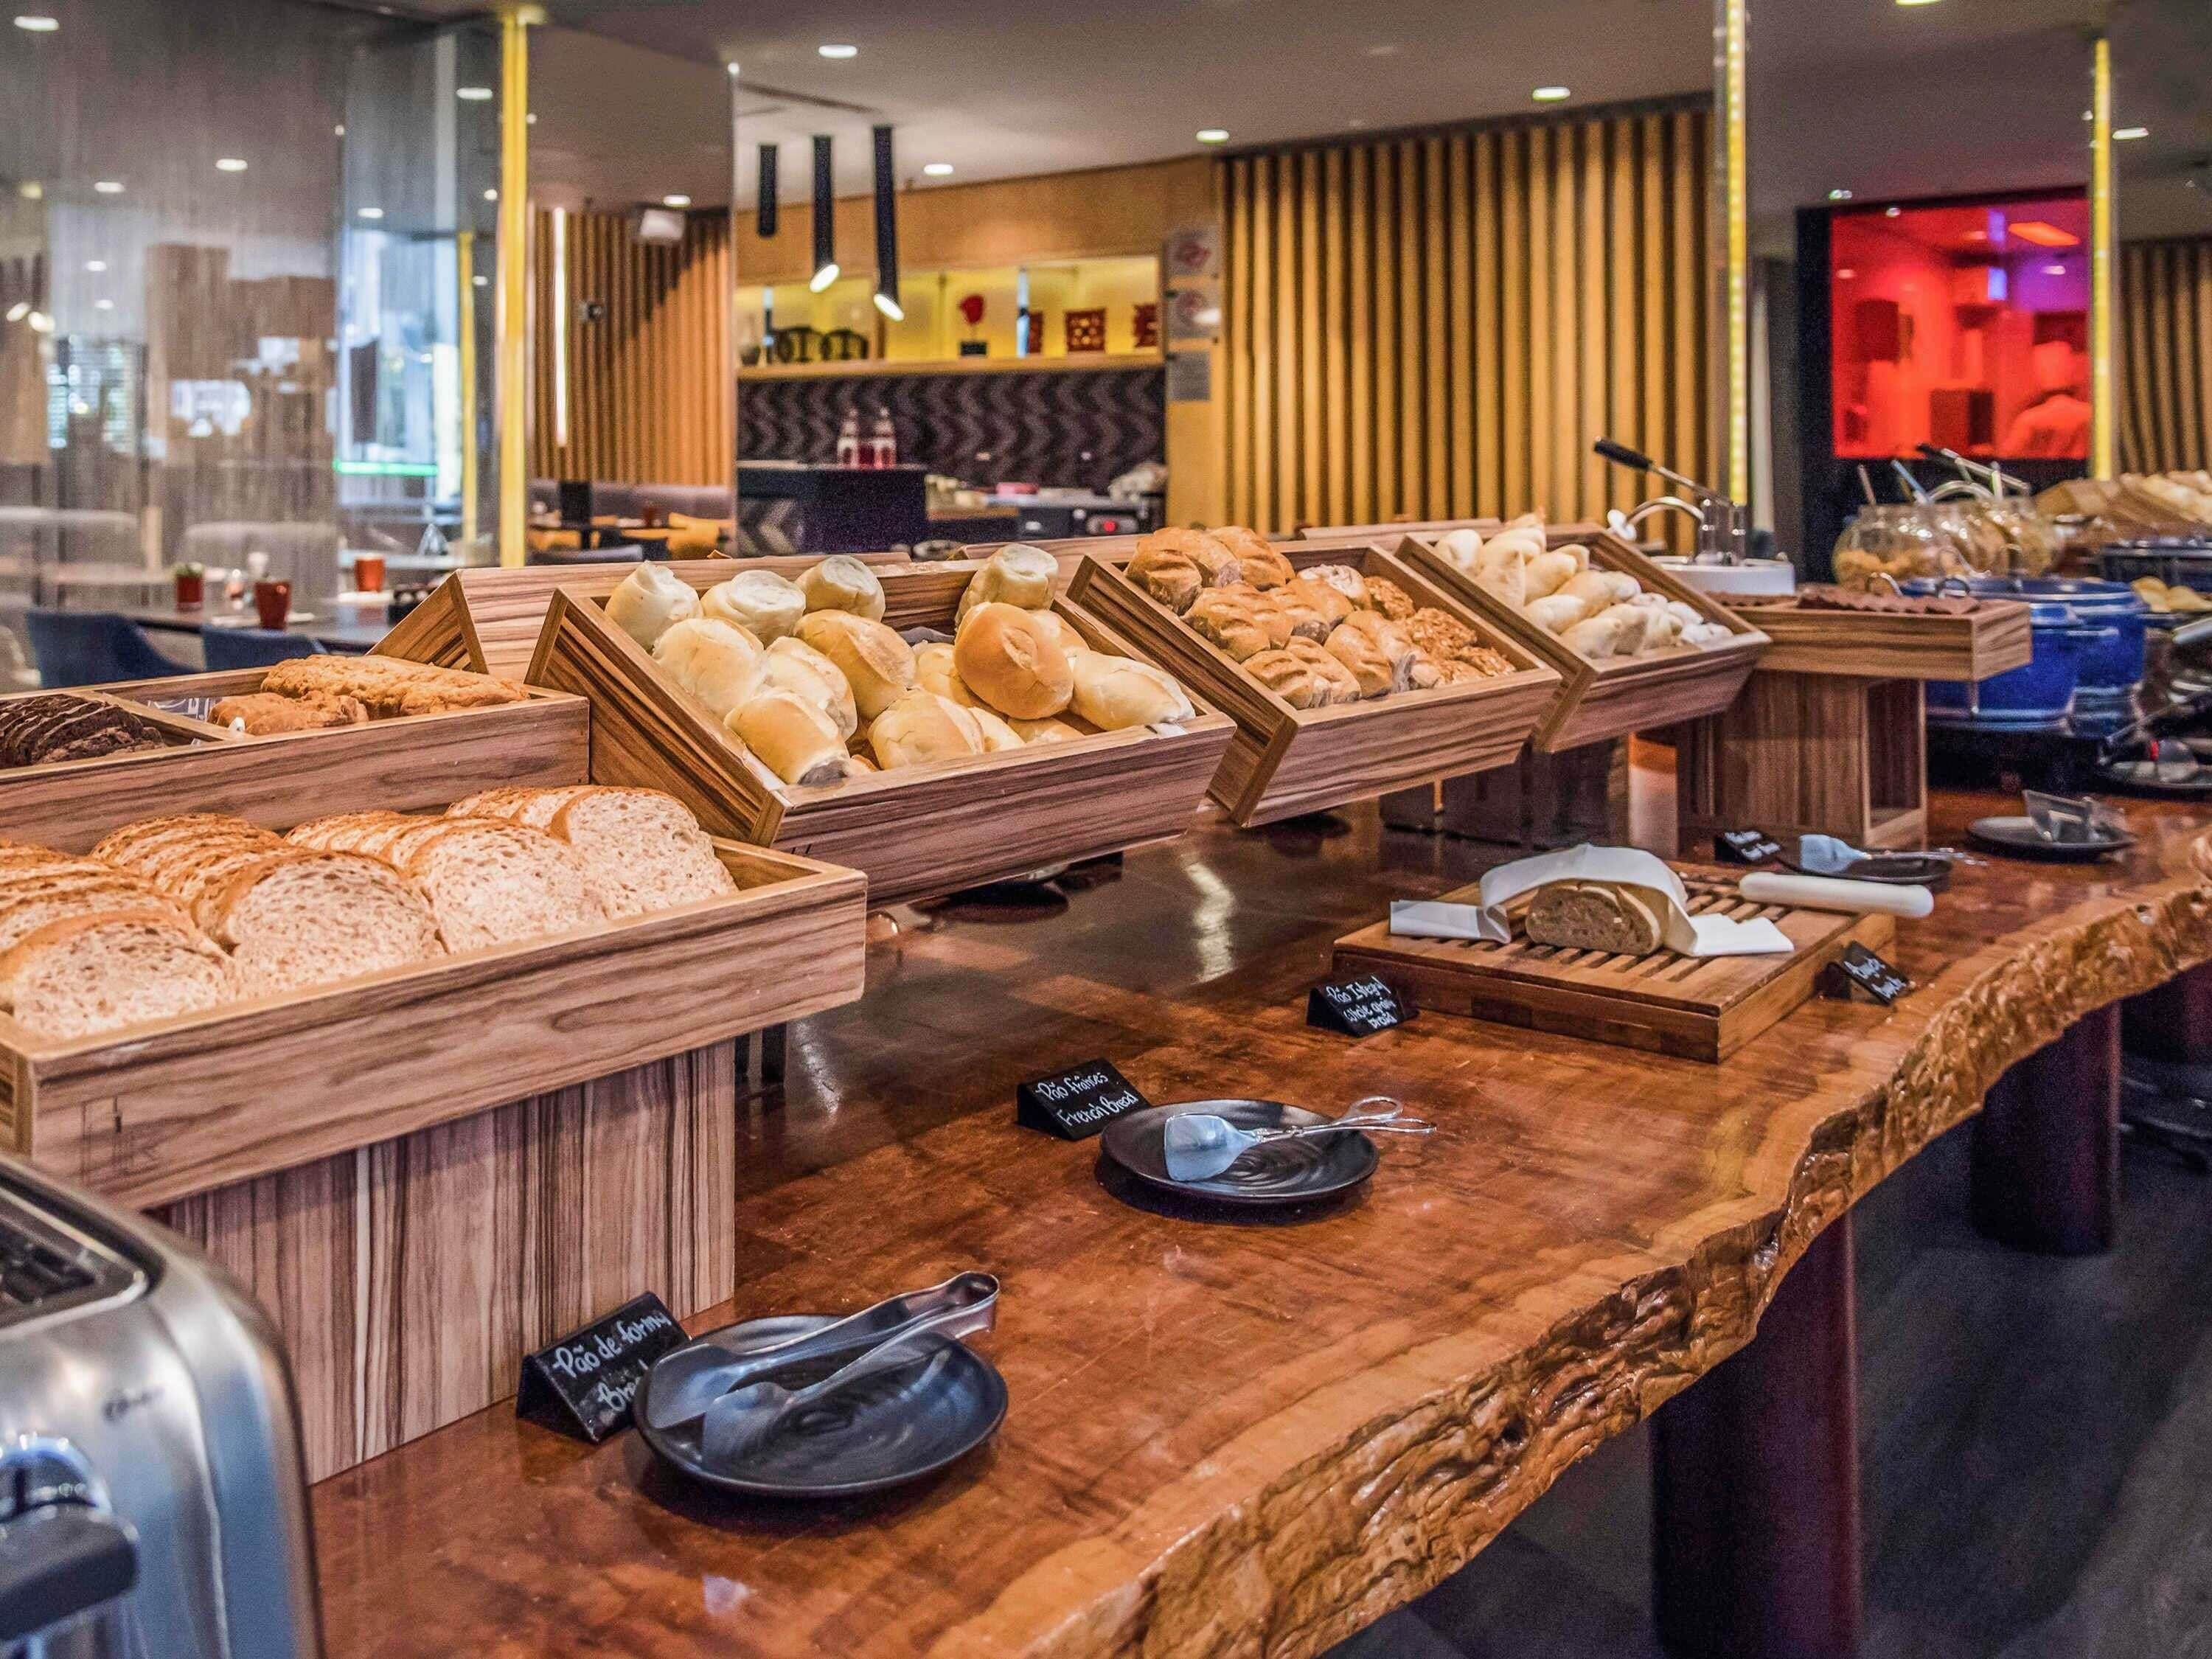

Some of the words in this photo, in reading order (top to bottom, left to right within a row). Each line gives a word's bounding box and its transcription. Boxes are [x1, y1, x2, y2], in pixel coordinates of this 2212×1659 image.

[1035, 1082, 1068, 1101] Pão
[1099, 1090, 1139, 1113] Bread
[553, 1345, 600, 1378] Pão
[594, 1335, 622, 1360] de
